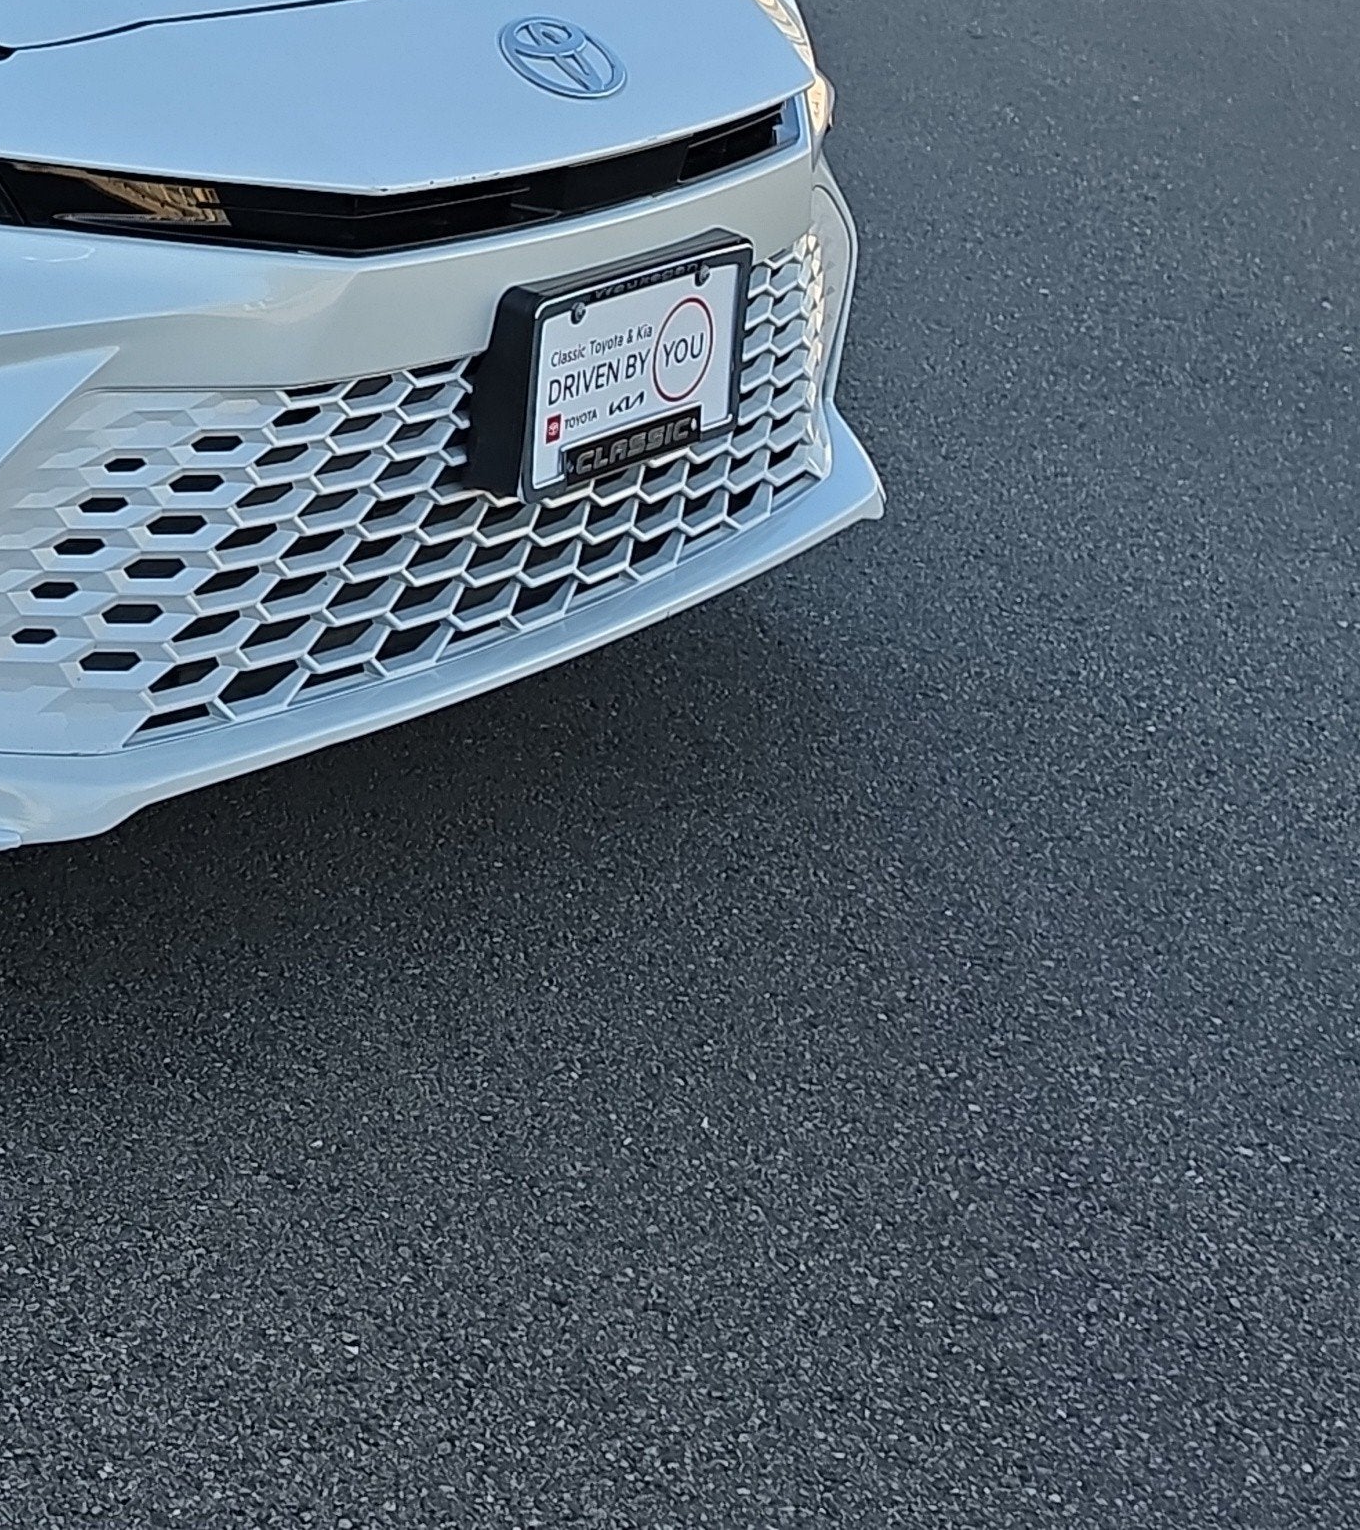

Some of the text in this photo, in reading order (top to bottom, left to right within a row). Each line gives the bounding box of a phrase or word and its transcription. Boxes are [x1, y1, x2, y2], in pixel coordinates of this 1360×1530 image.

[548, 332, 705, 406] DRIVEN BY YOU
[551, 324, 653, 367] Classic Toyota & Kia
[564, 409, 597, 430] TOYOTA
[576, 418, 692, 475] CLASSIC
